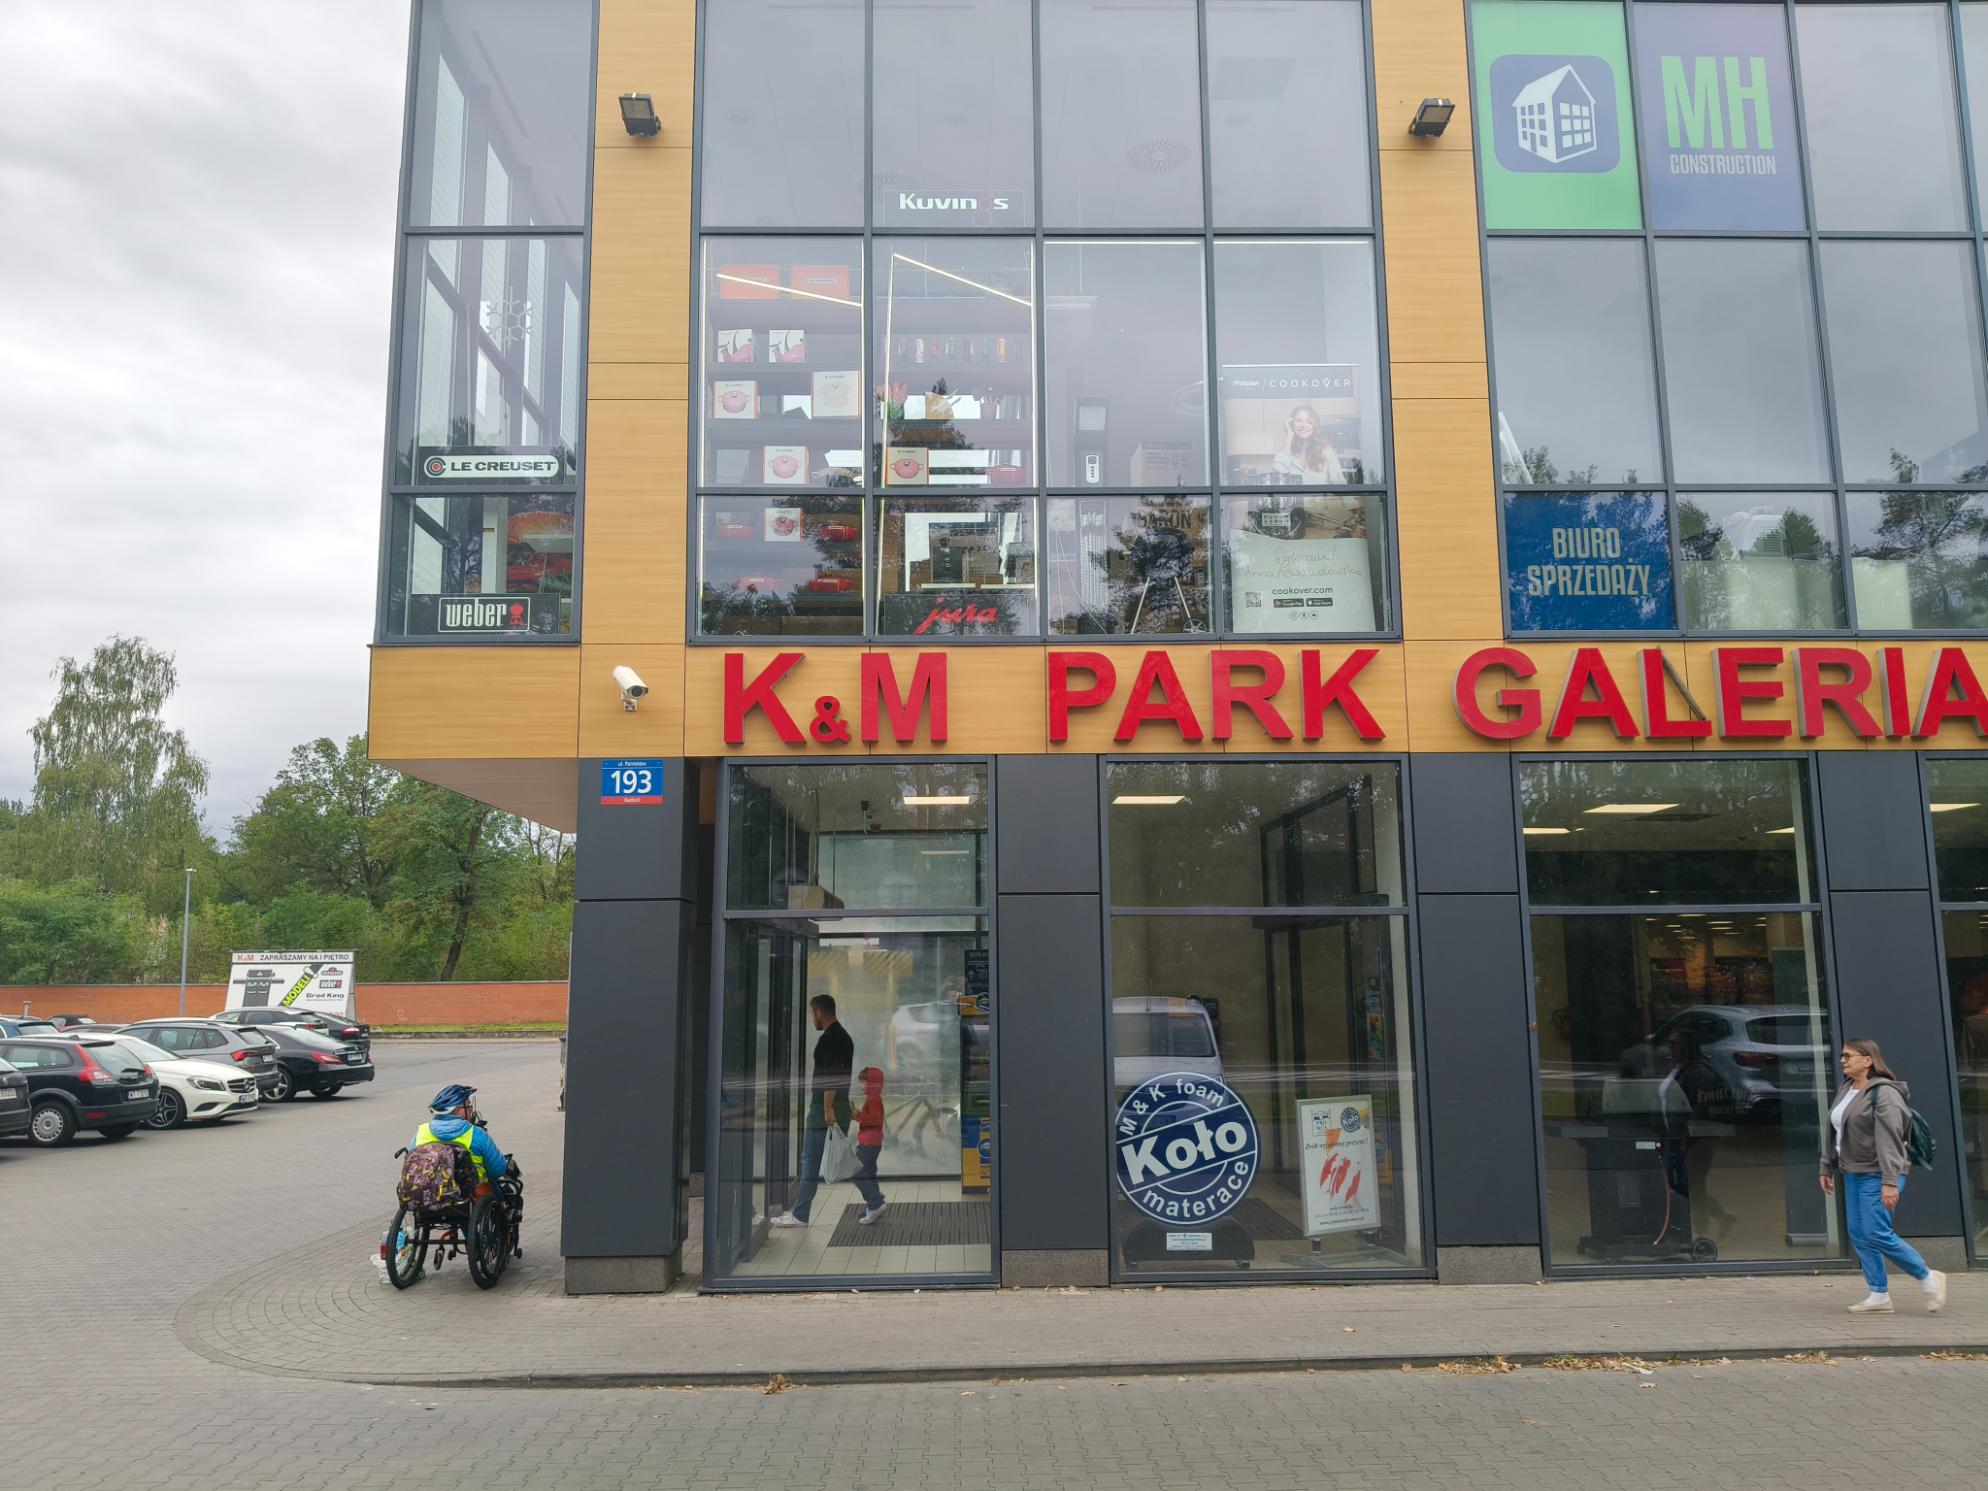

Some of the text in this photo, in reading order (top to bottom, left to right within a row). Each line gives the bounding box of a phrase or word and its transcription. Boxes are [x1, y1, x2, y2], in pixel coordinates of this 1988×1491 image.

[1660, 56, 1774, 149] MH
[1670, 154, 1777, 175] CONSTRUCTION
[1269, 377, 1351, 388] COOKOVER
[451, 461, 556, 472] LE CREUSET
[1552, 527, 1621, 559] BIURO
[1272, 586, 1334, 595] cookover.com
[1527, 558, 1650, 596] SPRZEDAŻY
[445, 599, 507, 627] weber
[912, 596, 998, 635] jura
[723, 647, 1988, 744] K&M PARK GALERIA
[611, 770, 652, 794] 193
[282, 974, 311, 1008] MODELI
[1119, 1078, 1225, 1136] M & K foam
[1121, 1119, 1248, 1186] Koło
[1143, 1160, 1249, 1218] materace
